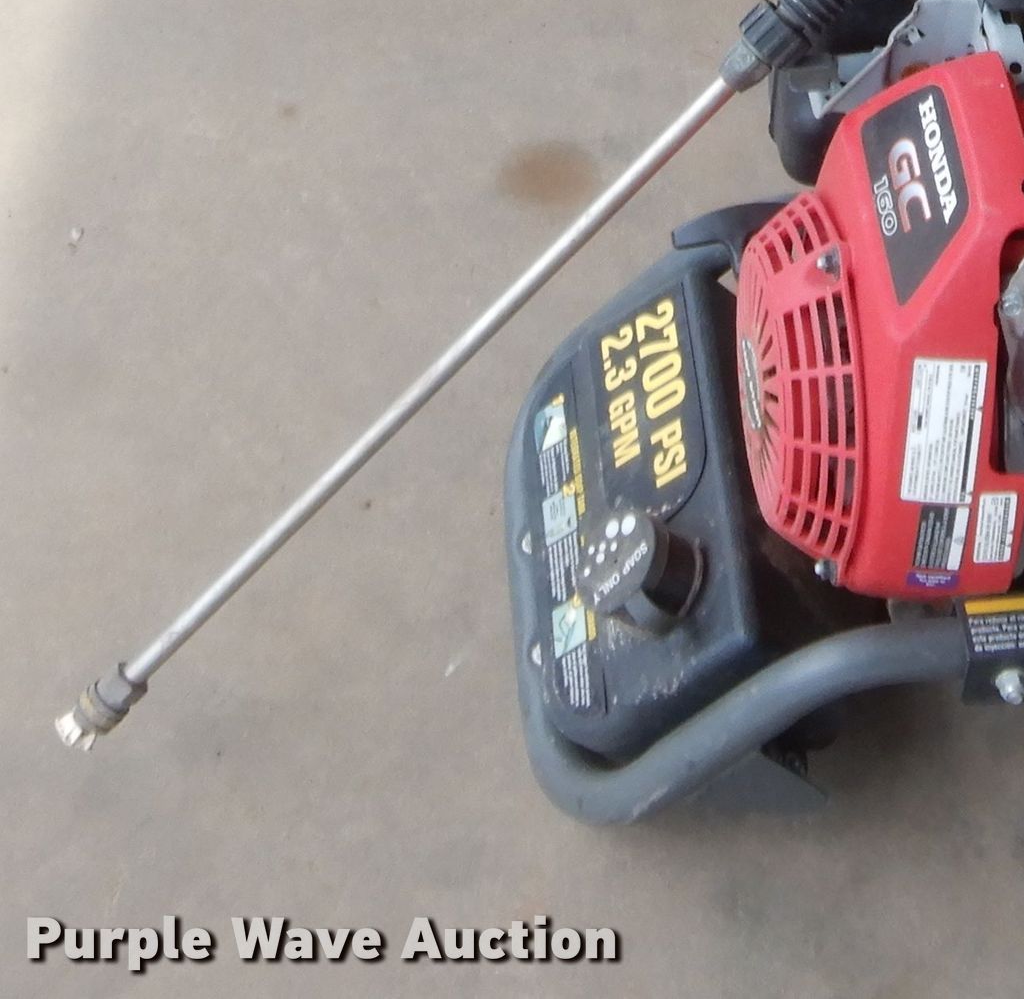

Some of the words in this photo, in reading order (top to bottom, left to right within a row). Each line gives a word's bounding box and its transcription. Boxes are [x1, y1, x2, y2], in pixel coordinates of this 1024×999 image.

[888, 138, 932, 233] GC
[918, 94, 958, 225] HONDA
[873, 174, 898, 237] 160
[601, 324, 637, 392] 2.3
[635, 298, 686, 420] 2700
[608, 390, 641, 468] GPM
[650, 418, 687, 488] PSI
[593, 573, 620, 606] ONLY
[622, 542, 648, 575] SOAP
